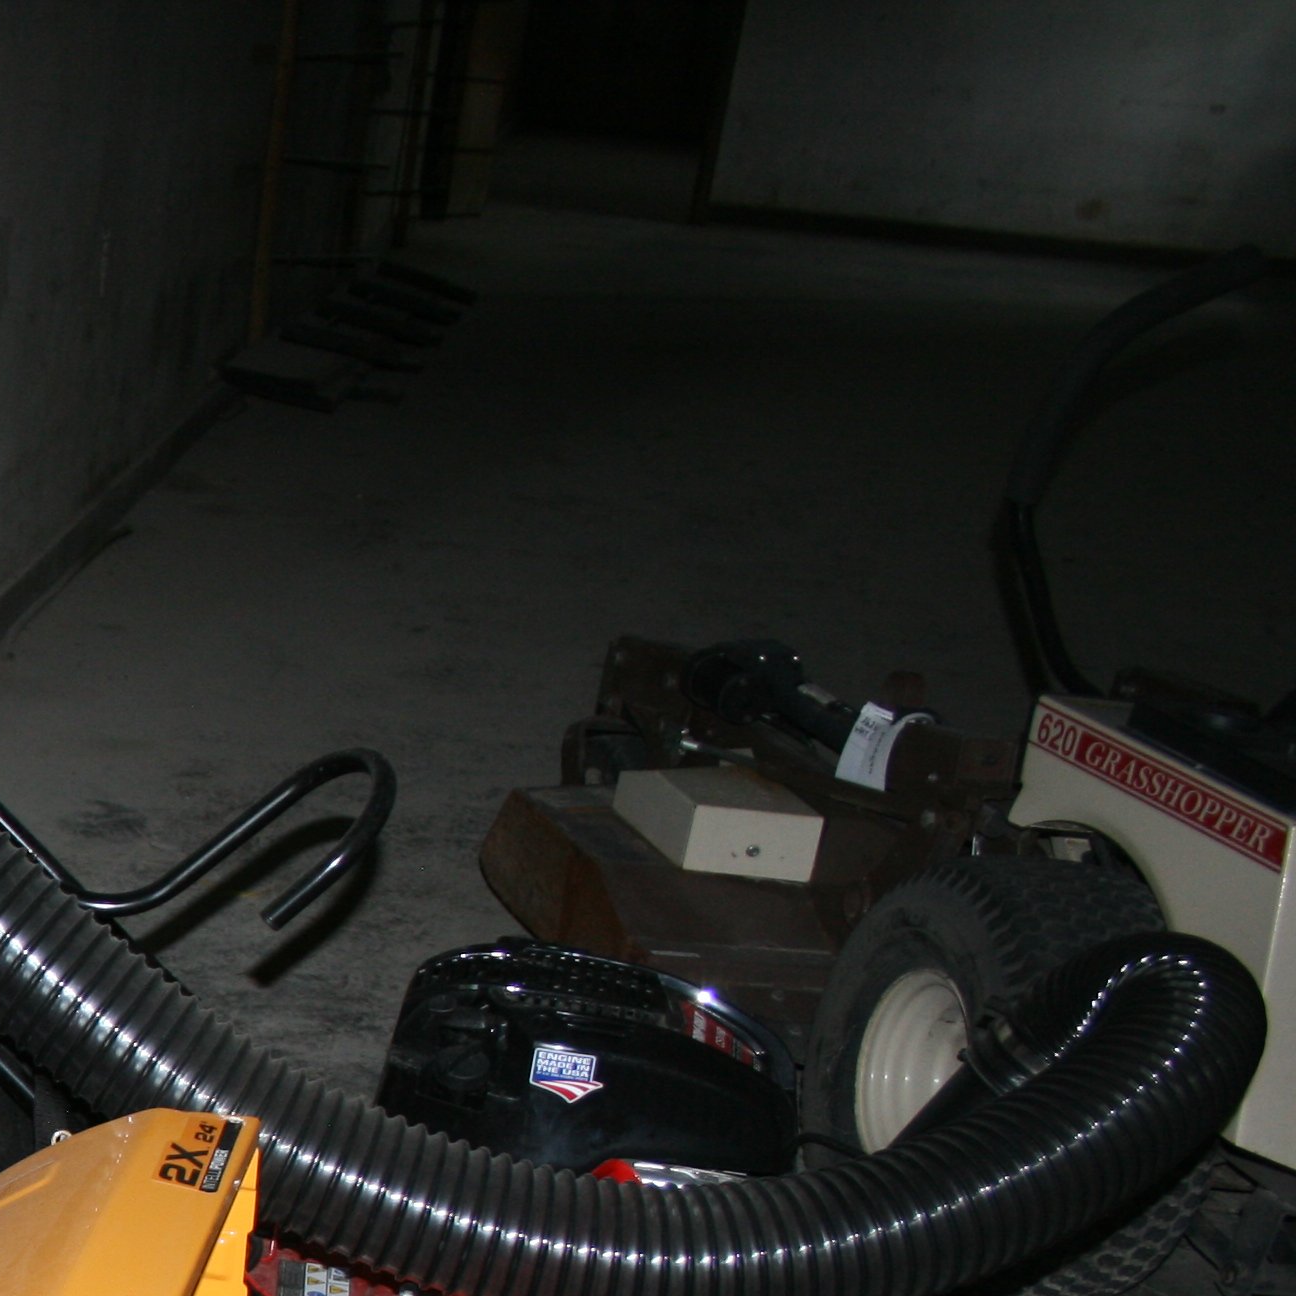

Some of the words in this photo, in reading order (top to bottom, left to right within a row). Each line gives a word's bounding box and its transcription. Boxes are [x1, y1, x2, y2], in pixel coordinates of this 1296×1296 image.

[1037, 713, 1077, 757] 620
[1085, 741, 1273, 853] GRASSHOPPER
[537, 1058, 574, 1070] MADE
[538, 1051, 591, 1065] ENGINE
[537, 1065, 559, 1074] THE
[562, 1068, 589, 1078] USA
[159, 1142, 209, 1187] 2X
